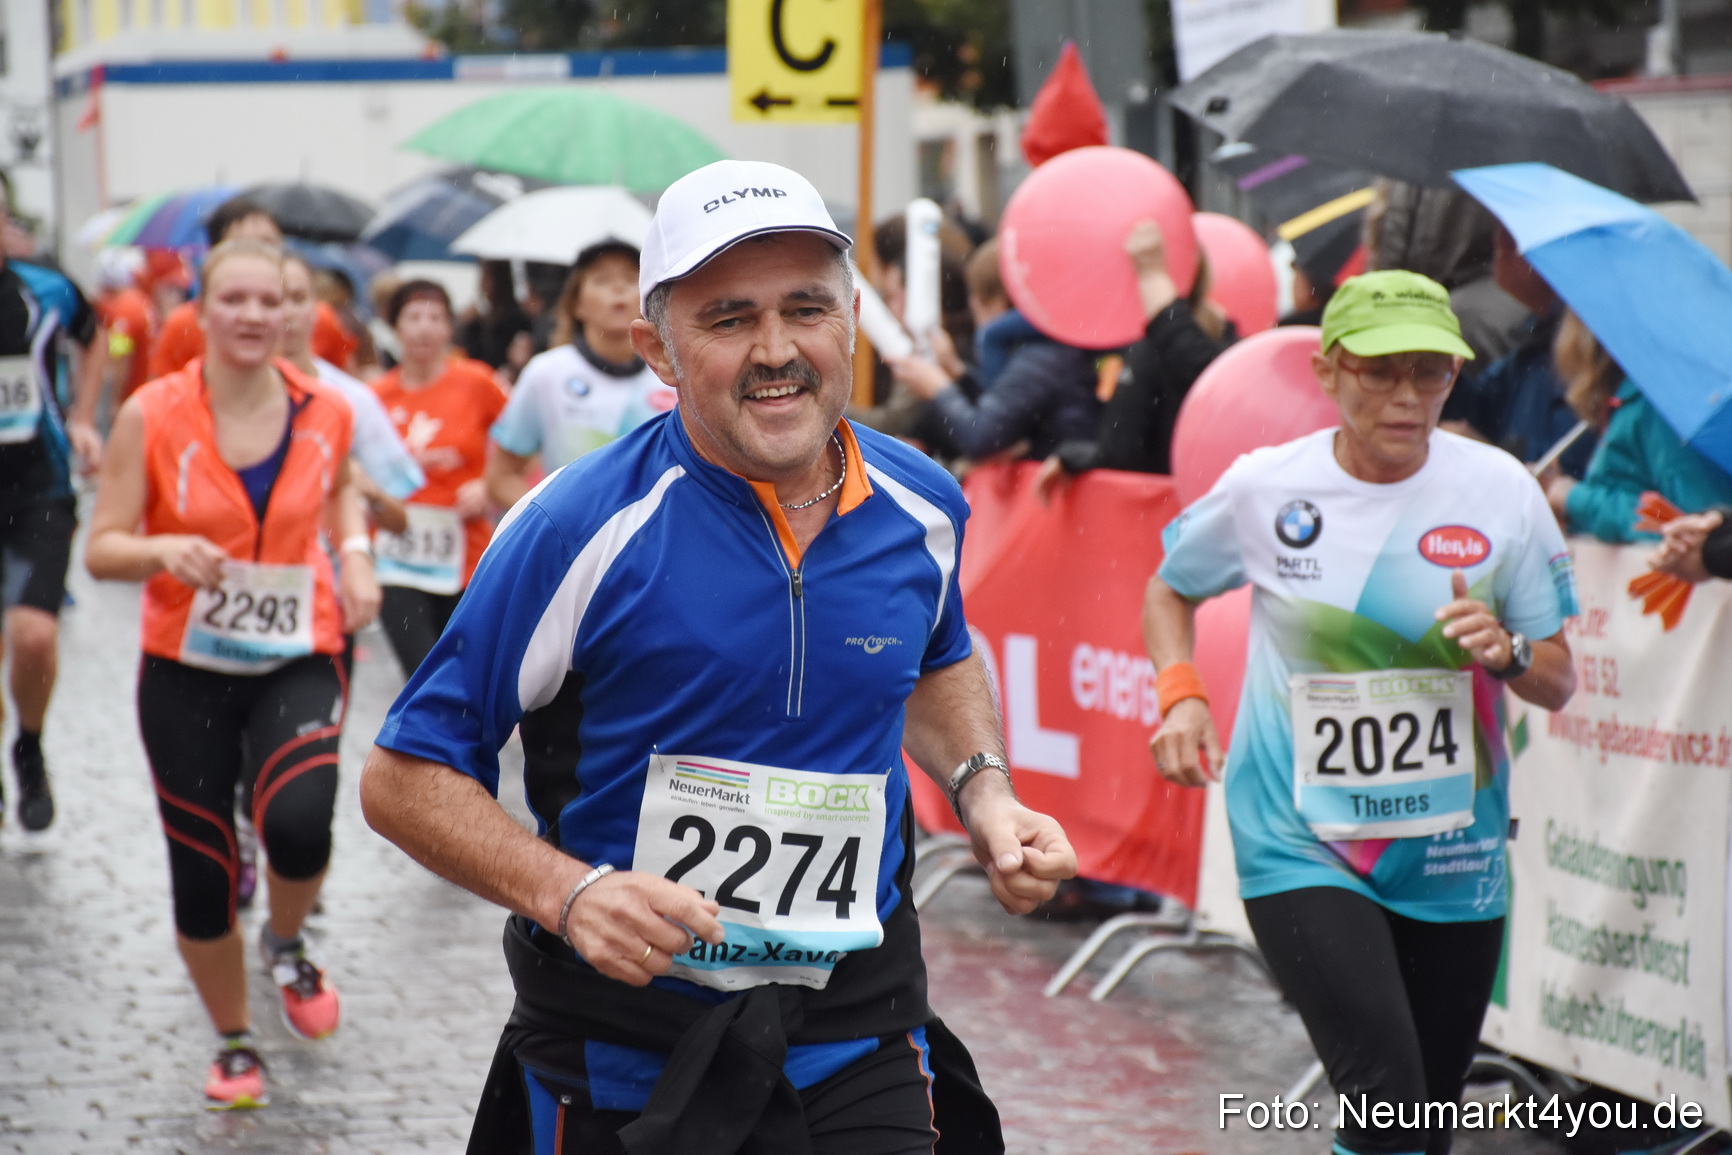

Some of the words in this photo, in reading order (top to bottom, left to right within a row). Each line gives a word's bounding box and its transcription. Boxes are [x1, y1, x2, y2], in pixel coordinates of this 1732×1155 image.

[703, 187, 787, 213] OLYMP
[203, 589, 298, 634] 2293
[1315, 707, 1459, 777] 2024
[668, 778, 751, 805] NeuerMarkt
[670, 794, 698, 805] einkaufen
[765, 776, 870, 812] BOCK
[764, 806, 801, 818] inspired
[803, 811, 815, 820] by
[839, 814, 870, 823] concepts
[1350, 793, 1430, 818] Theres
[664, 815, 861, 919] 2274
